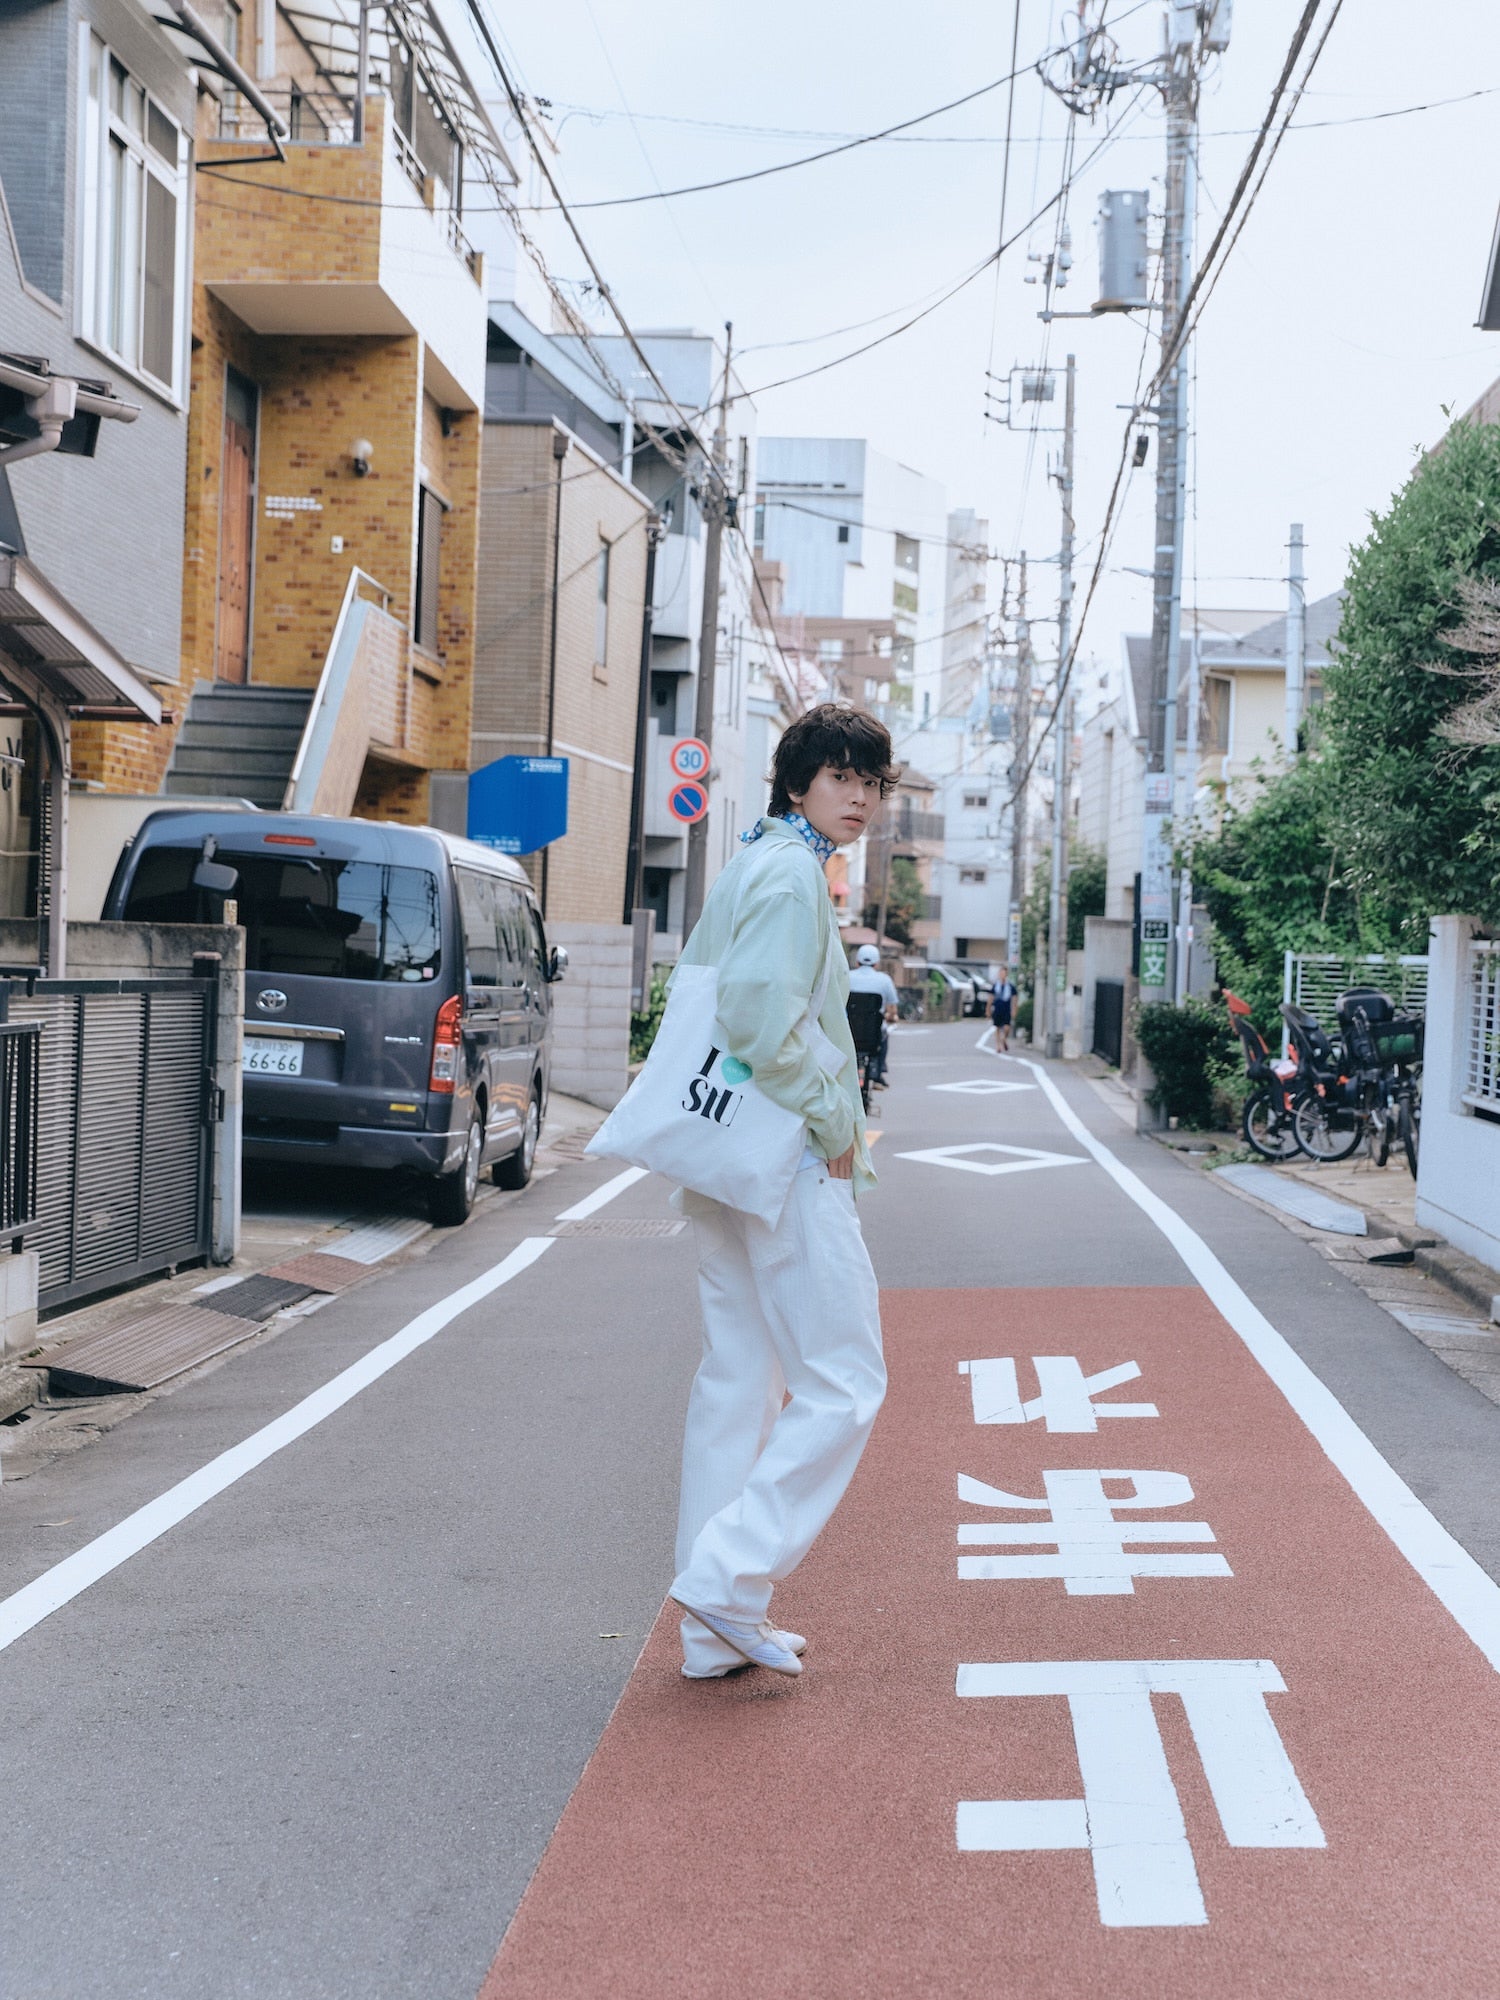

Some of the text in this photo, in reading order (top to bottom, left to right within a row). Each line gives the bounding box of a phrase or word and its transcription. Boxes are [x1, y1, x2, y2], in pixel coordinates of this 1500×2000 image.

[679, 750, 702, 769] 30
[1143, 953, 1165, 978] 文
[249, 1052, 298, 1072] 66-66
[696, 1044, 724, 1079] I
